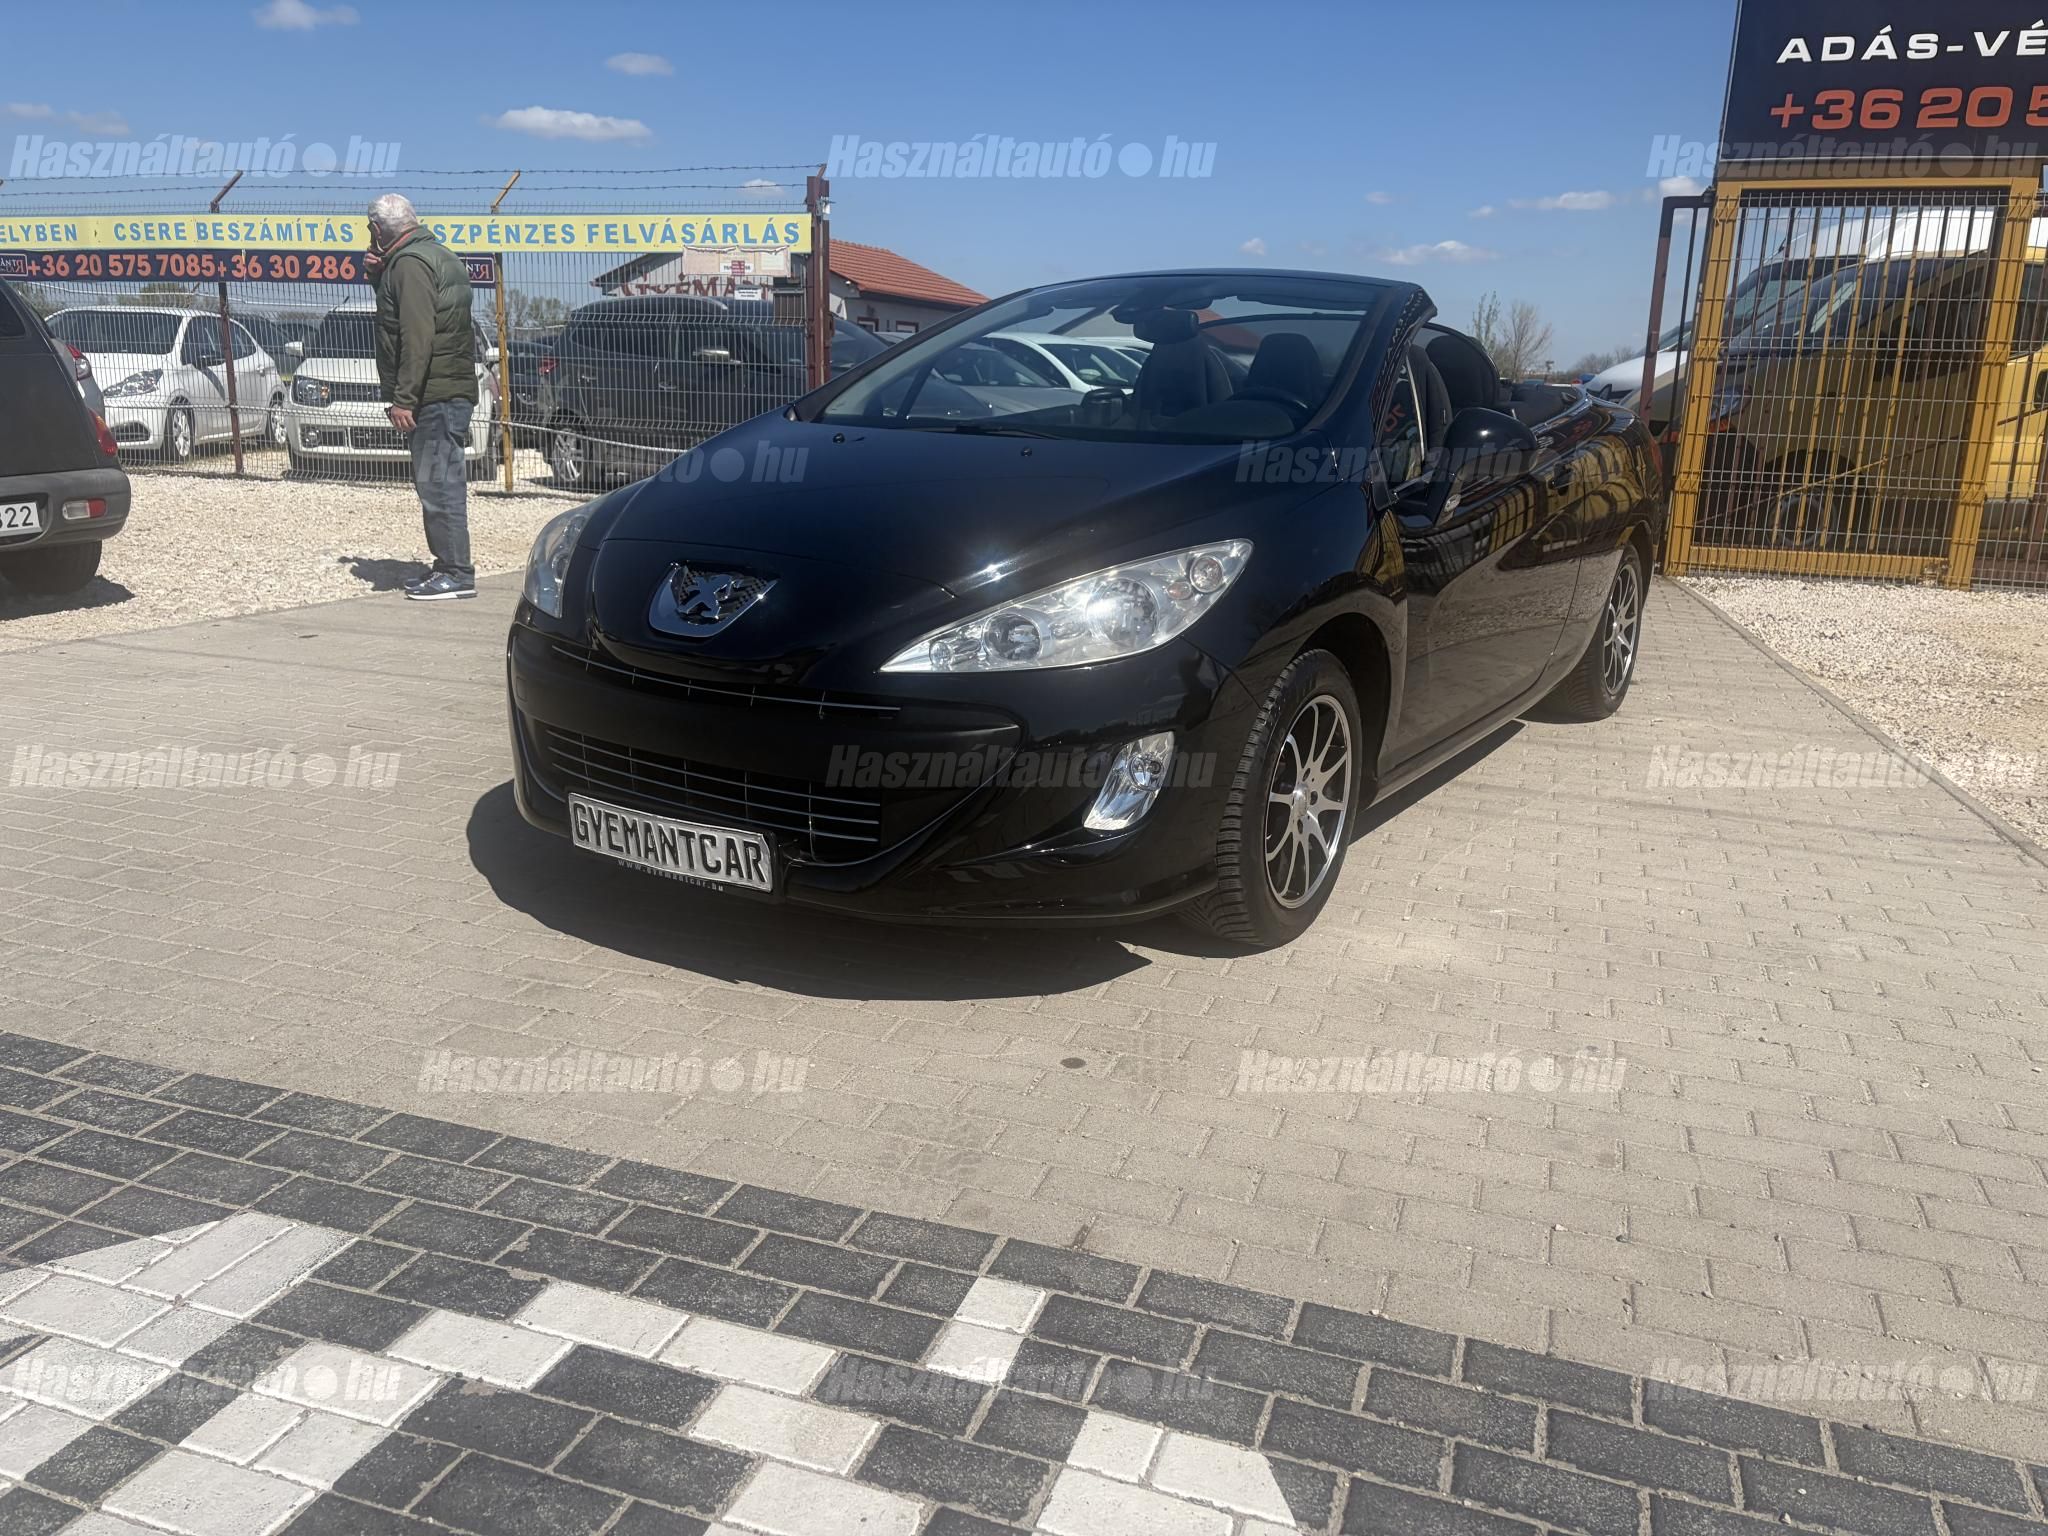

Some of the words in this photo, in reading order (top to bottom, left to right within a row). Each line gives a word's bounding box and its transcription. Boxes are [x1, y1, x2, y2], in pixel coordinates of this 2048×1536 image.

[1770, 88, 1904, 130] +36
[1915, 86, 2014, 129] 20
[0, 223, 77, 242] ELYBEN
[113, 221, 187, 242] CSERE
[196, 217, 354, 243] BESZÁMÍTÁS
[420, 218, 576, 244] SZPÉNZES
[587, 217, 801, 245] FELVÁSÁRLÁS
[28, 254, 70, 278] +36
[75, 254, 102, 277] 20
[108, 254, 152, 277] 575
[155, 253, 216, 277] 7085
[269, 254, 299, 279] 30
[306, 254, 356, 280] 286
[0, 505, 34, 528] 22
[572, 802, 768, 883] GYEMANTCAR
